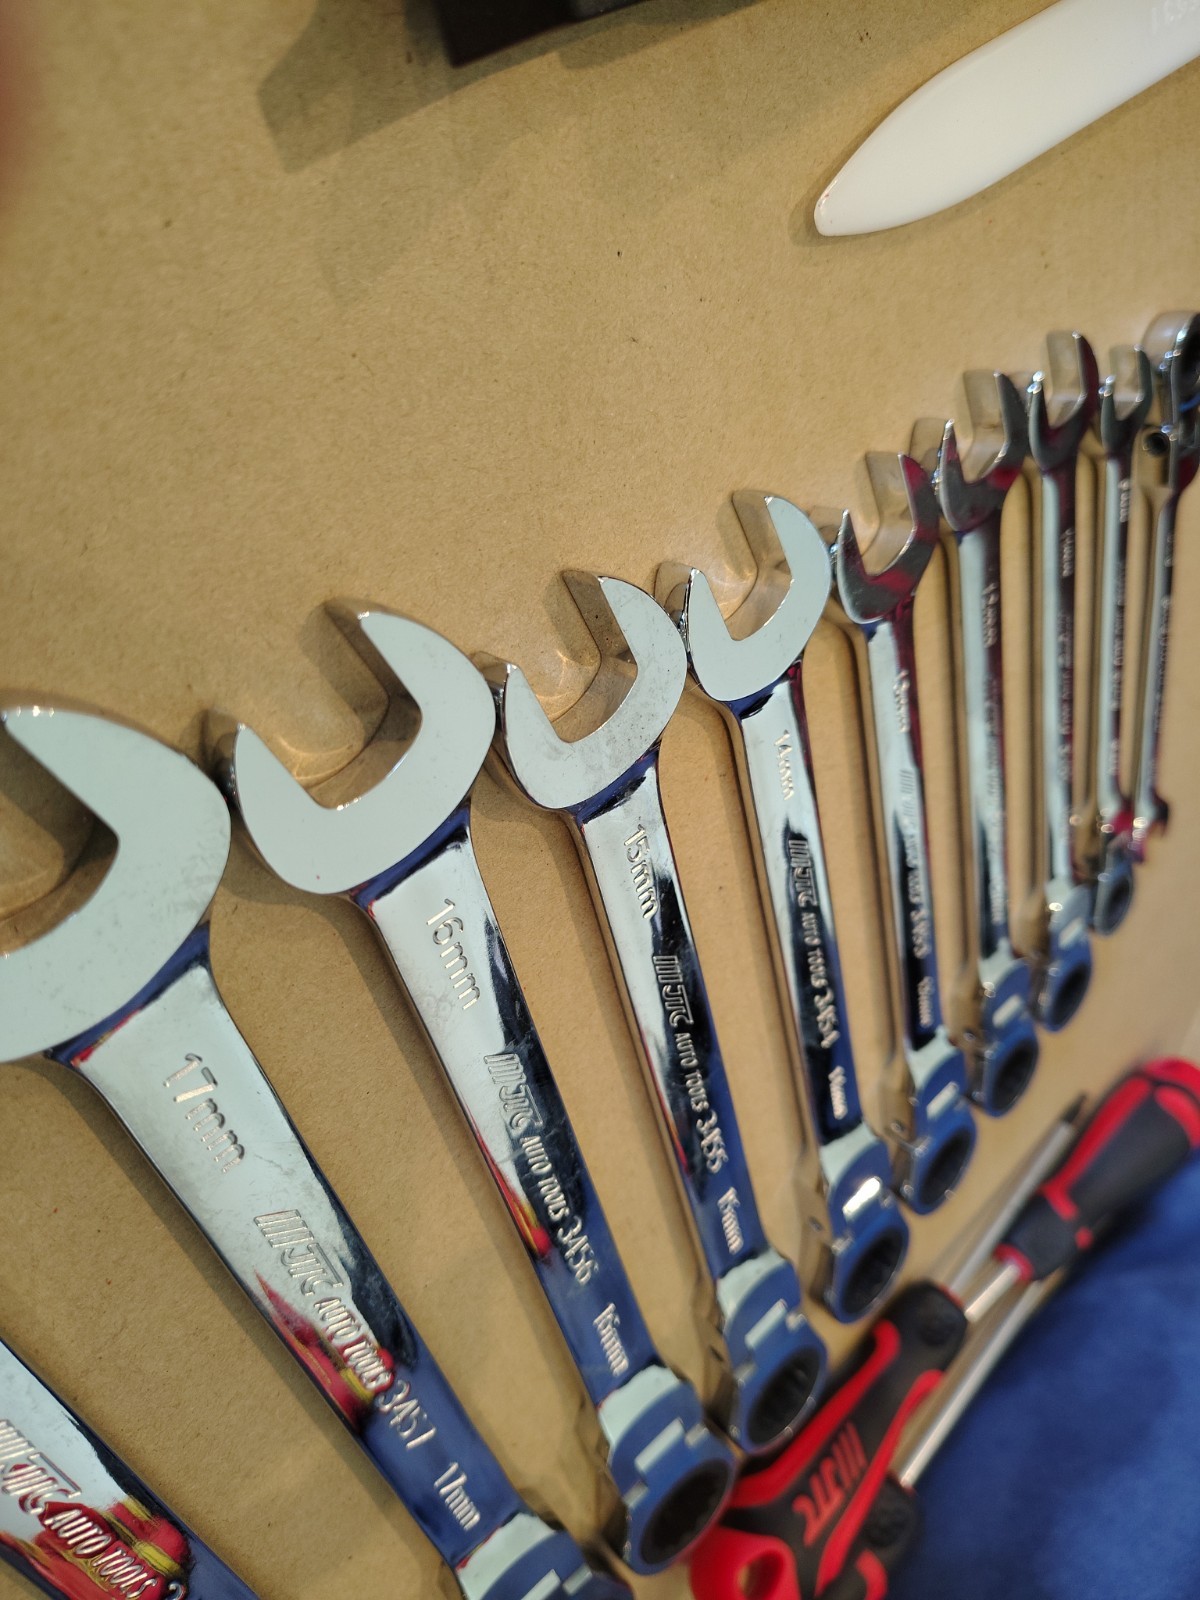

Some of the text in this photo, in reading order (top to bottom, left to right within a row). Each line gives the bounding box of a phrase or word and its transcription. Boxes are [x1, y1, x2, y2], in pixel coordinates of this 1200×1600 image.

[774, 730, 795, 801] 14mm
[623, 823, 661, 920] 15mm
[427, 898, 482, 1009] 16mm
[801, 912, 821, 946] AUTO
[807, 947, 828, 989] TOOLS
[675, 1032, 698, 1069] AUTO
[814, 988, 840, 1049] 3454
[163, 1053, 246, 1174] 17mm
[685, 1069, 709, 1113] TOOLS
[696, 1108, 729, 1174] 3455
[520, 1136, 552, 1175] AUTO
[537, 1173, 570, 1221] TOOLS
[556, 1215, 599, 1286] 3456
[593, 1303, 629, 1377] 16mm
[314, 1297, 361, 1343] AUTO
[343, 1339, 392, 1390] TOOLS
[375, 1379, 436, 1449] 3457
[434, 1462, 481, 1531] 17mm
[44, 1508, 112, 1555] AUTO
[92, 1547, 158, 1599] TOOLS
